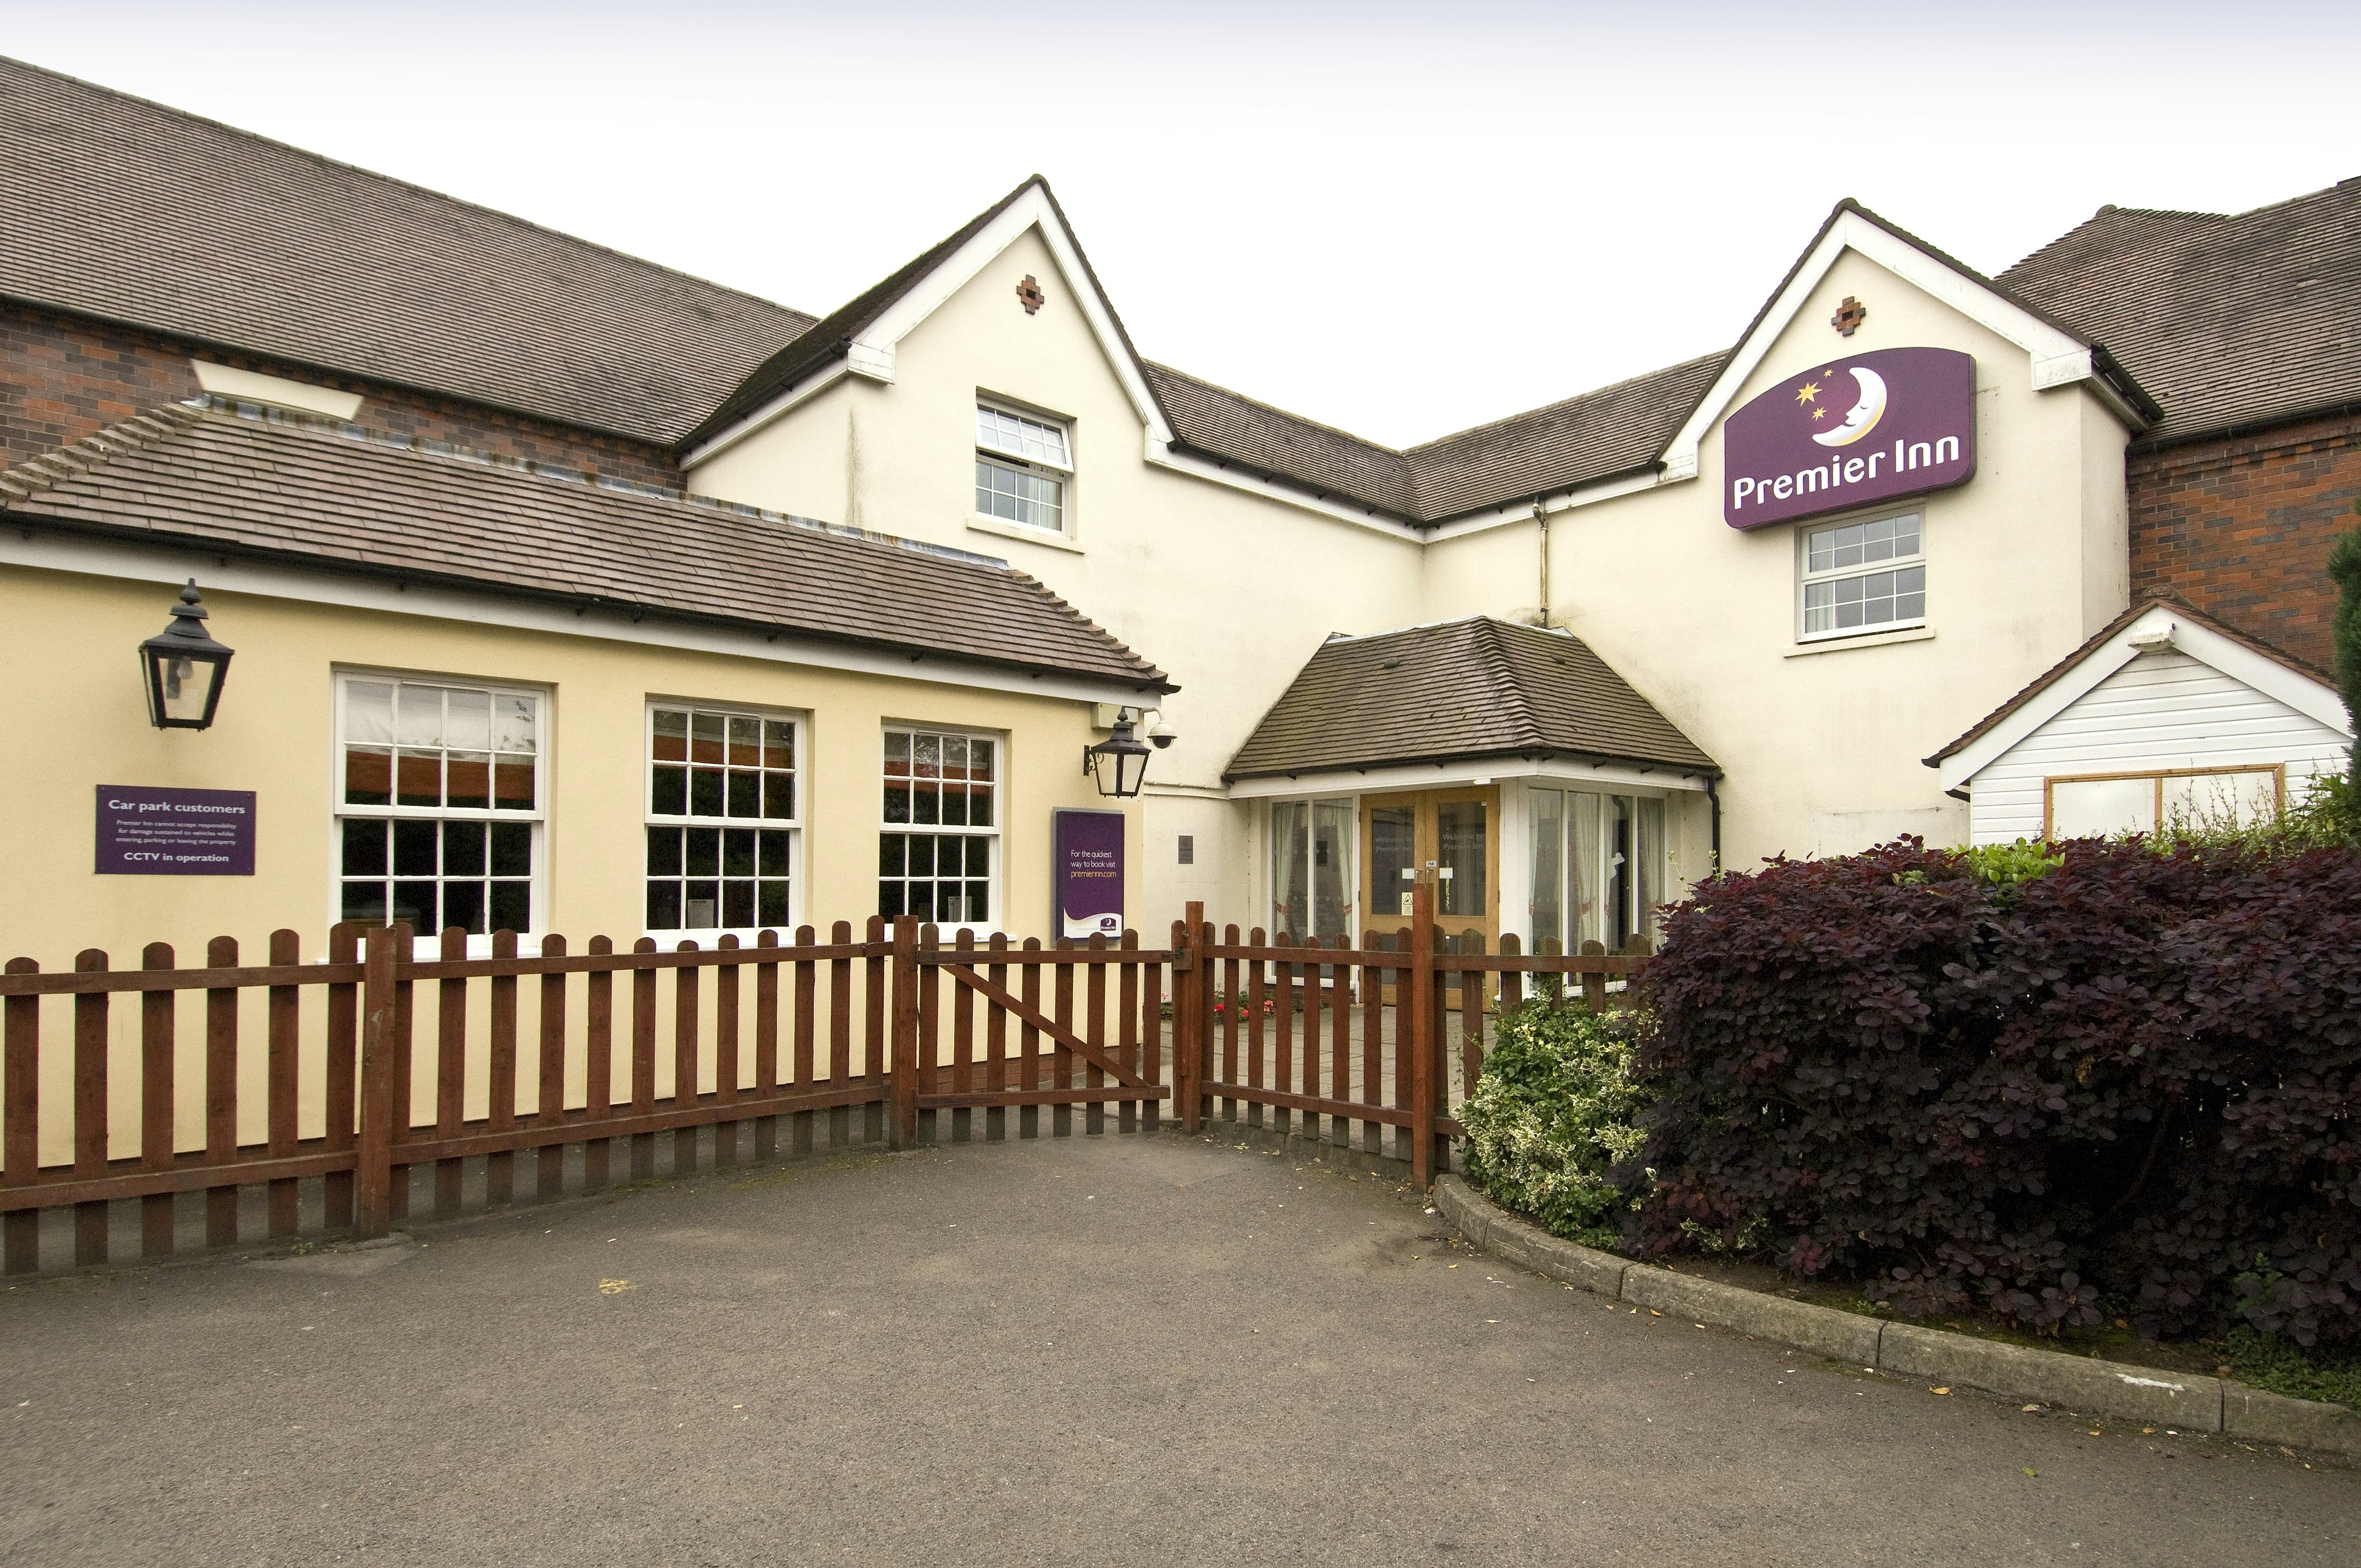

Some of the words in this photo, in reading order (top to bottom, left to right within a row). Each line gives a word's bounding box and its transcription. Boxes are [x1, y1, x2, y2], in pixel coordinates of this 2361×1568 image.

[1734, 451, 1886, 509] Premier
[1895, 436, 1960, 473] Inn
[108, 800, 135, 810] Car
[139, 802, 171, 813] park
[175, 805, 246, 814] customers
[124, 852, 160, 861] CCTV
[176, 854, 229, 863] operation
[1091, 850, 1112, 859] quickest
[1071, 869, 1117, 880] premierinn.com
